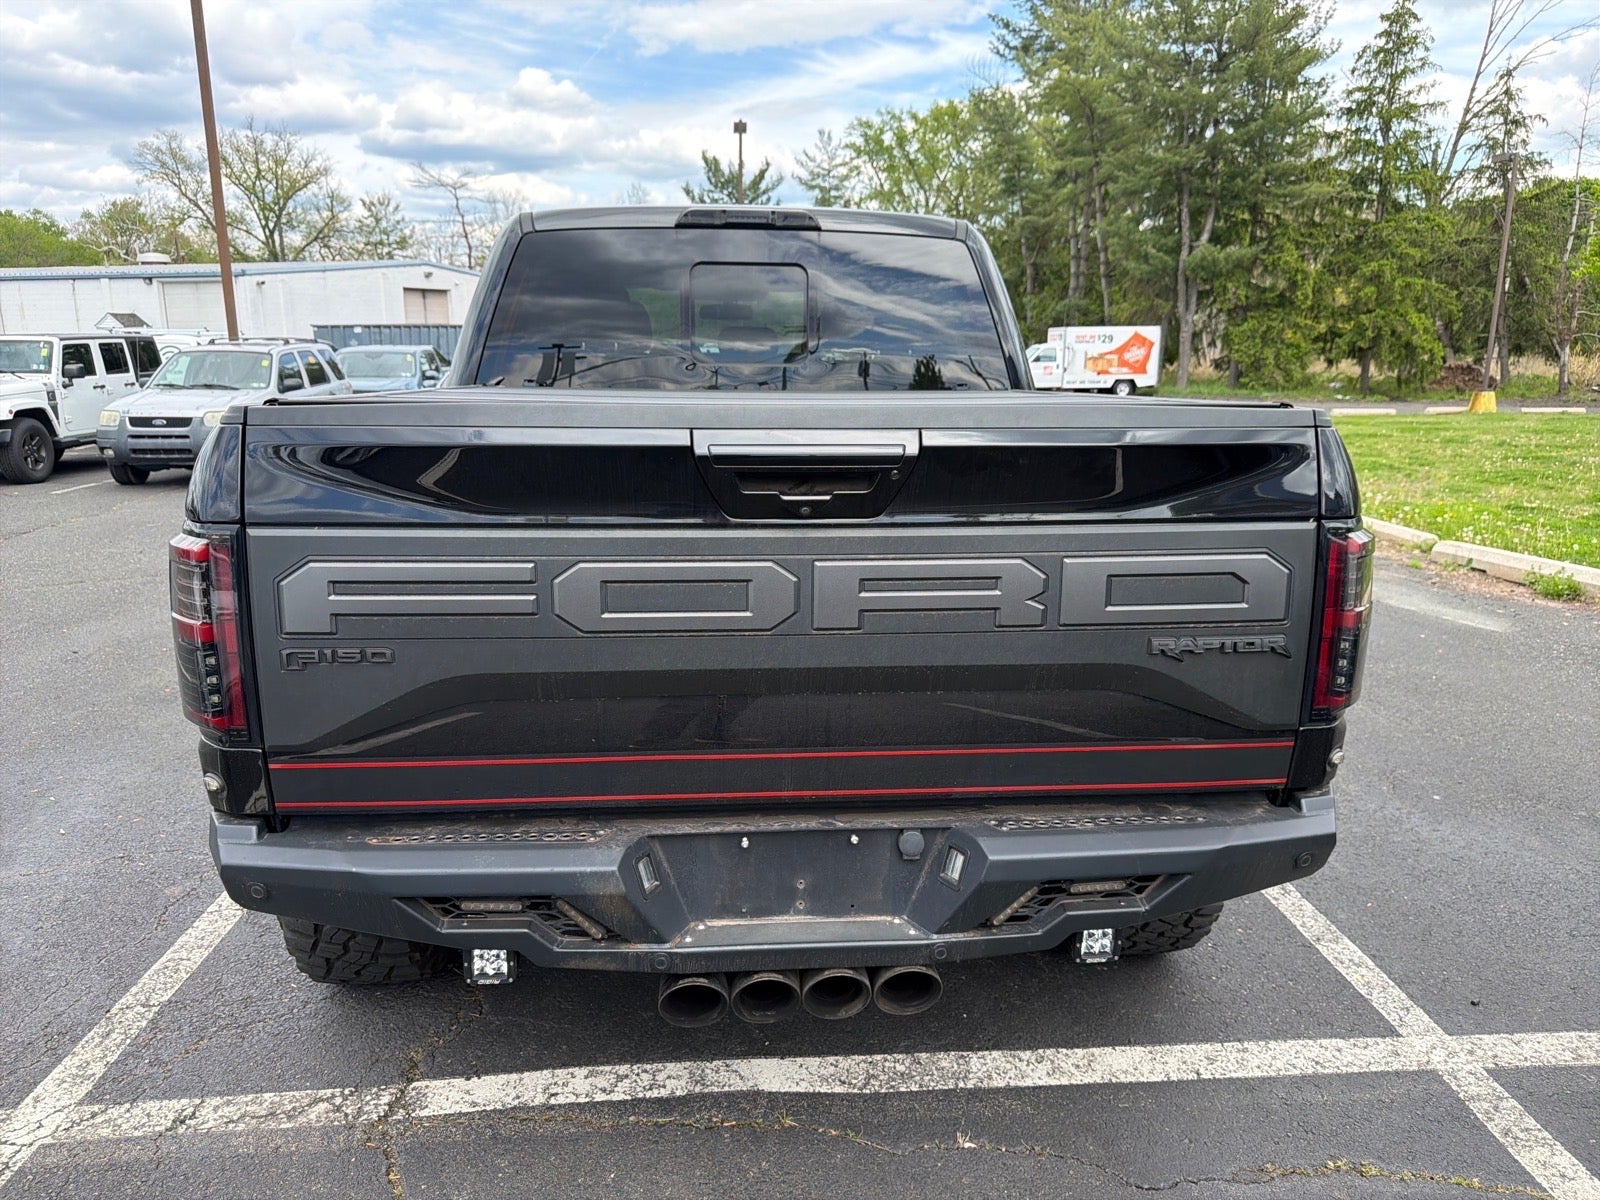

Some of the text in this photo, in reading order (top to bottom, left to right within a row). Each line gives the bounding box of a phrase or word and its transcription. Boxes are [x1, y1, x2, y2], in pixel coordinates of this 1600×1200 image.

[1097, 334, 1114, 344] $29
[279, 554, 1289, 634] FORD
[280, 647, 396, 671] F150
[1149, 634, 1292, 662] RAPTOR
